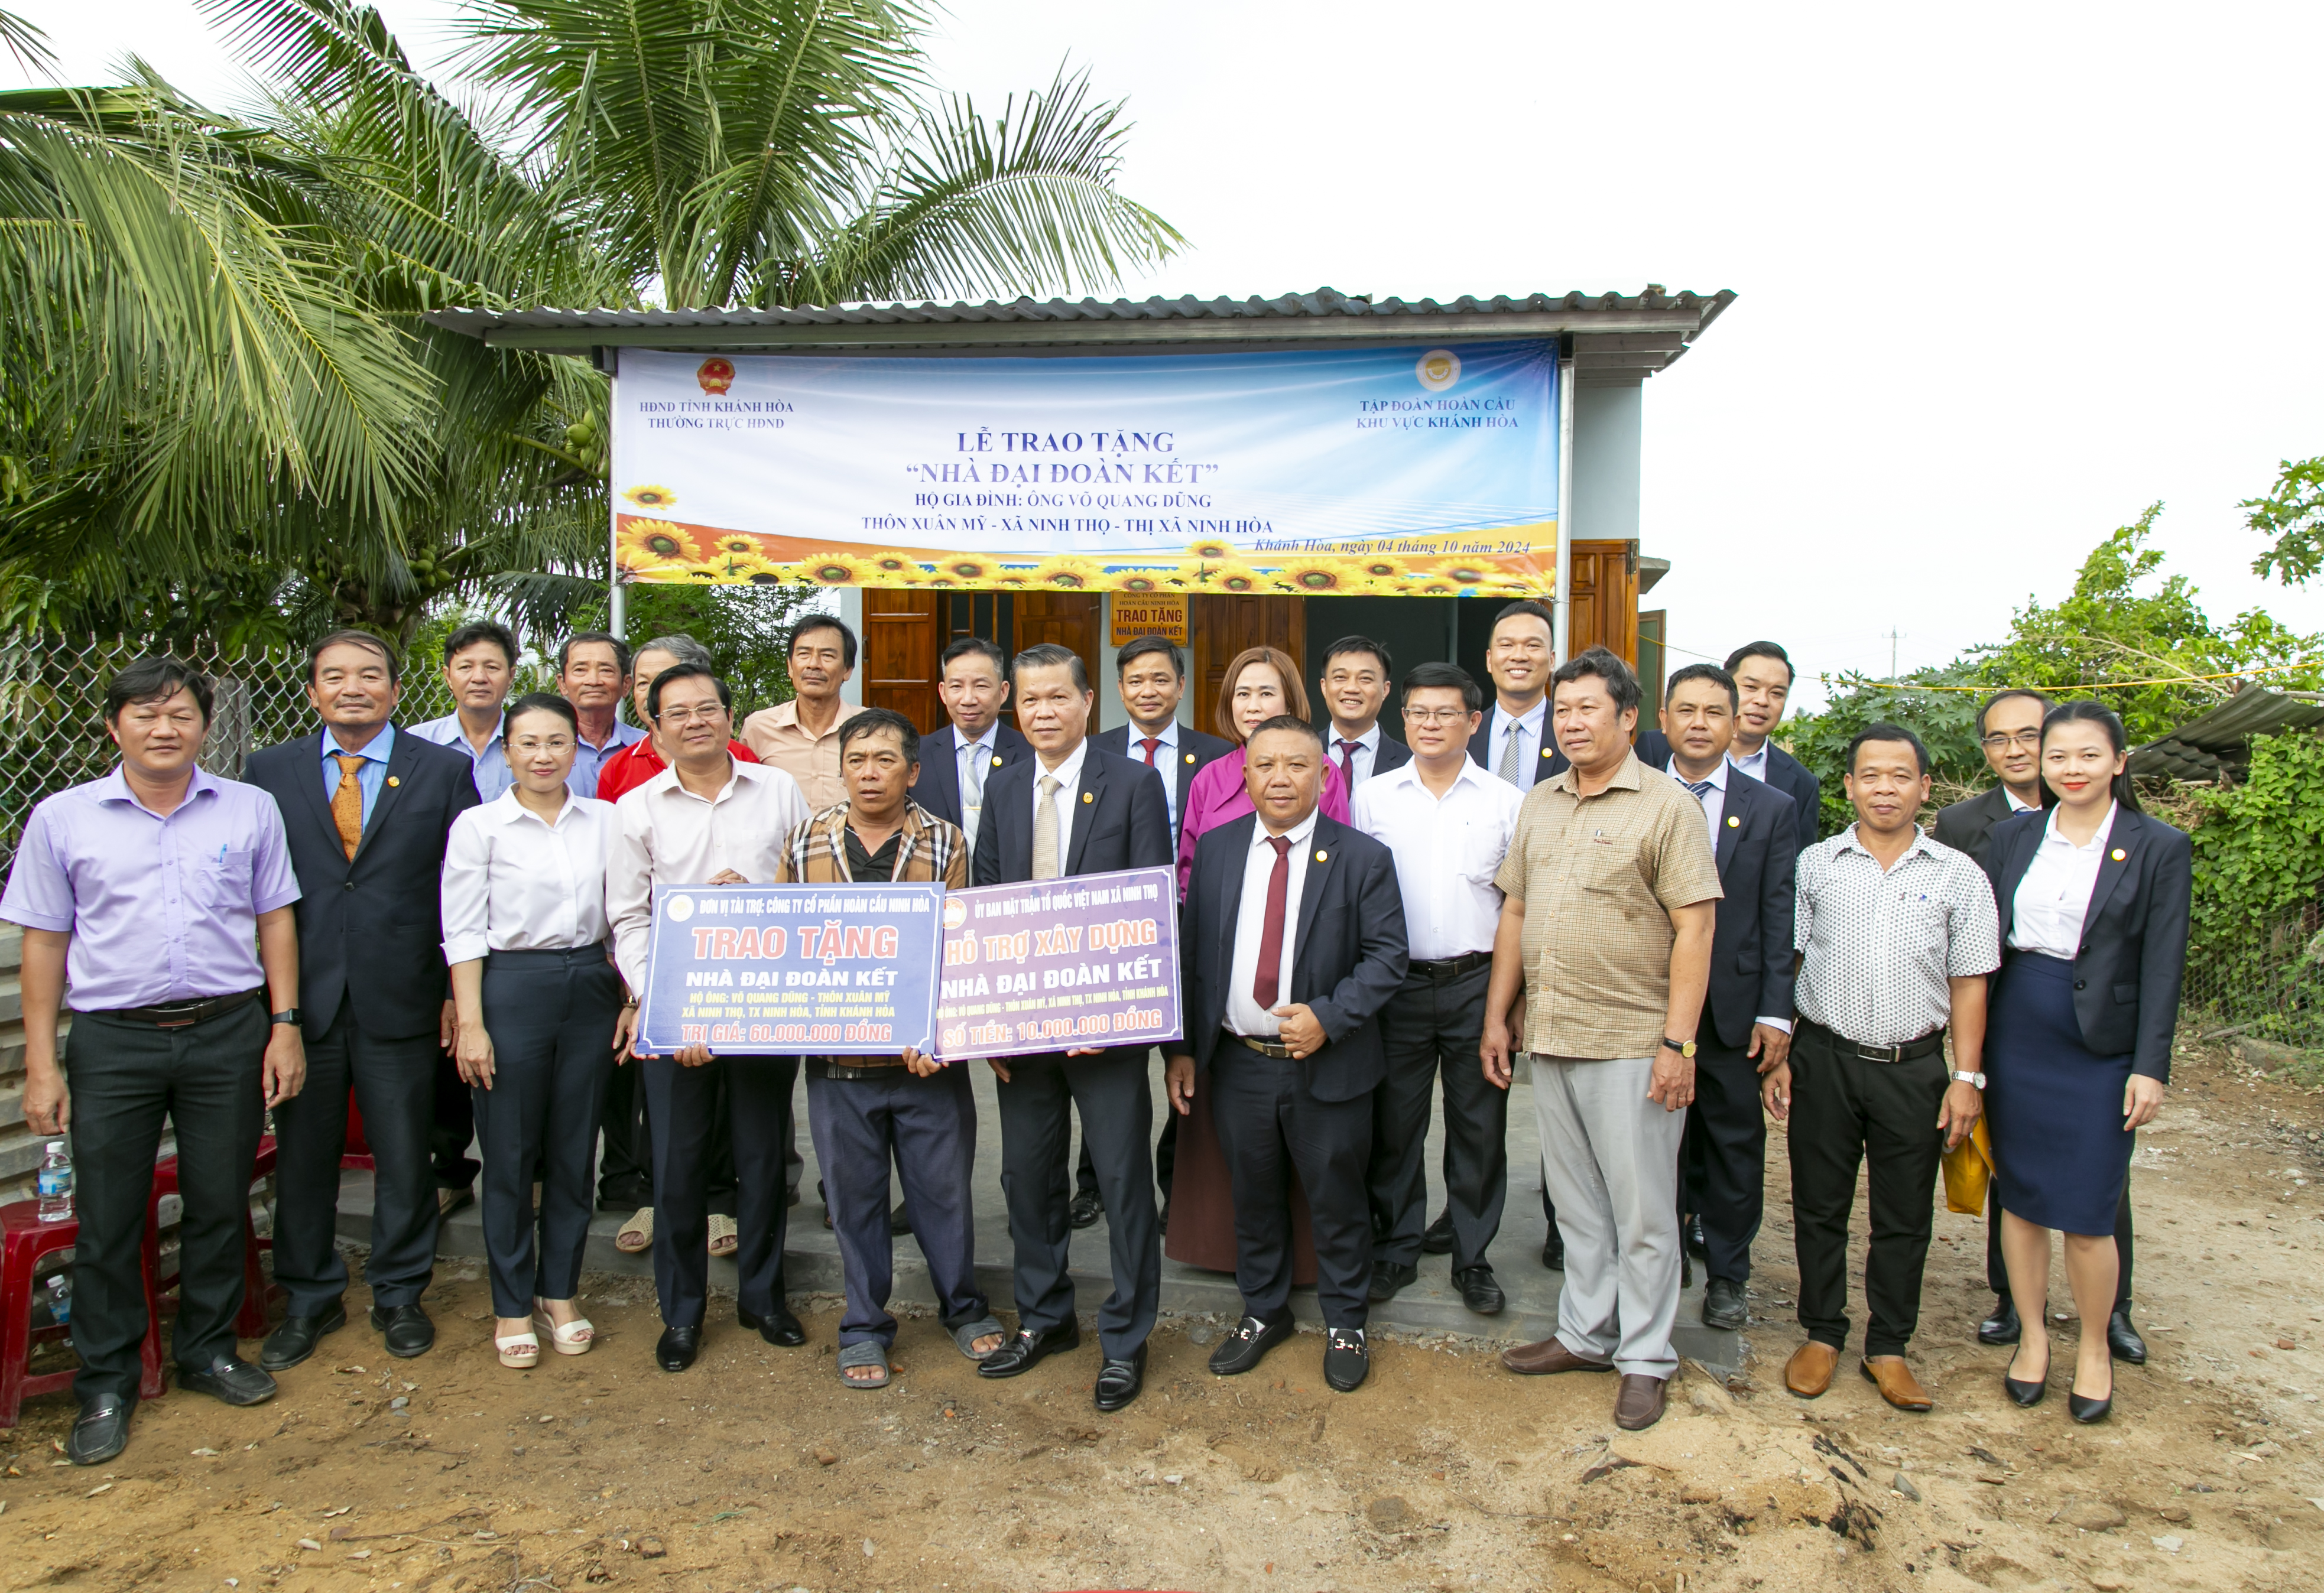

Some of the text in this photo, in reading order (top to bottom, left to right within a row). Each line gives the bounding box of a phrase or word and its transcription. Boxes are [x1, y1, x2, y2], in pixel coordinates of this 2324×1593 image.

[640, 399, 794, 413] HĐND TỈNH KHÁNH HÒA
[1360, 396, 1515, 414] TẬP ĐOÀN HOÀN CẦU
[648, 415, 785, 431] THƯỜNG TRỰC HĐND
[1356, 414, 1518, 431] KHU VỰC KHÁNH HÒA
[957, 427, 1175, 457] LỄ TRAO TẶNG
[907, 457, 1219, 487] “NHÀ ĐẠI ĐOÀN KẾT”
[915, 490, 1212, 510] HỘ GIA ĐÌNH: ÔNG VÕ QUANG DŨNG
[862, 513, 907, 531] THÔN
[911, 513, 956, 531] XUÂN
[961, 513, 987, 531] MỸ
[1001, 515, 1023, 531] XÃ
[1028, 519, 1069, 532] NINH
[1075, 519, 1111, 535] THỌ
[1124, 519, 1154, 535] THỊ
[1157, 516, 1183, 532] XÃ
[1187, 519, 1231, 532] NINH
[1236, 516, 1273, 533] HÒA
[1255, 539, 1530, 556] Khánh Hòa, ngày 04 tháng 10 năm 2024
[1116, 607, 1182, 625] TRAO TẶNG
[1116, 625, 1182, 637] NHÀ ĐẠI ĐOÀN KẾT
[700, 893, 929, 917] ĐƠN VỊ TÀI TRỢ: CÔNG TY CỔ PHẦN HOÀN CẦU NINH HÒA
[975, 884, 1158, 919] ỦY BAN MẶT TRẬN TỔ QUỐC VIỆT NAM XÃ NINH THỌ
[692, 919, 898, 965] TRAO TẶNG
[946, 919, 1157, 966] HỖ TRỢ XÂY DỰNG
[686, 966, 898, 990] NHÀ ĐẠI ĐOÀN KẾT
[942, 954, 1162, 999] NHÀ ĐẠI ĐOÀN KẾT
[690, 993, 704, 1004] HỘ
[706, 990, 729, 1003] ÔNG:
[731, 990, 744, 1003] VÕ
[746, 993, 779, 1005] QUANG
[781, 990, 809, 1003] DŨNG
[817, 990, 844, 1003] THÔN
[845, 990, 872, 1002] XUÂN
[875, 990, 890, 1002] MỸ
[682, 1003, 895, 1020] XÃ NINH THỌ, TX NINH HÒA, TỈNH KHÁNH HÒA
[681, 1019, 892, 1045] TRỊ GIÁ: 60.000.000 ĐỒNG
[943, 1005, 1163, 1048] SỐ TIỀN: 10.000.000 ĐỒNG
